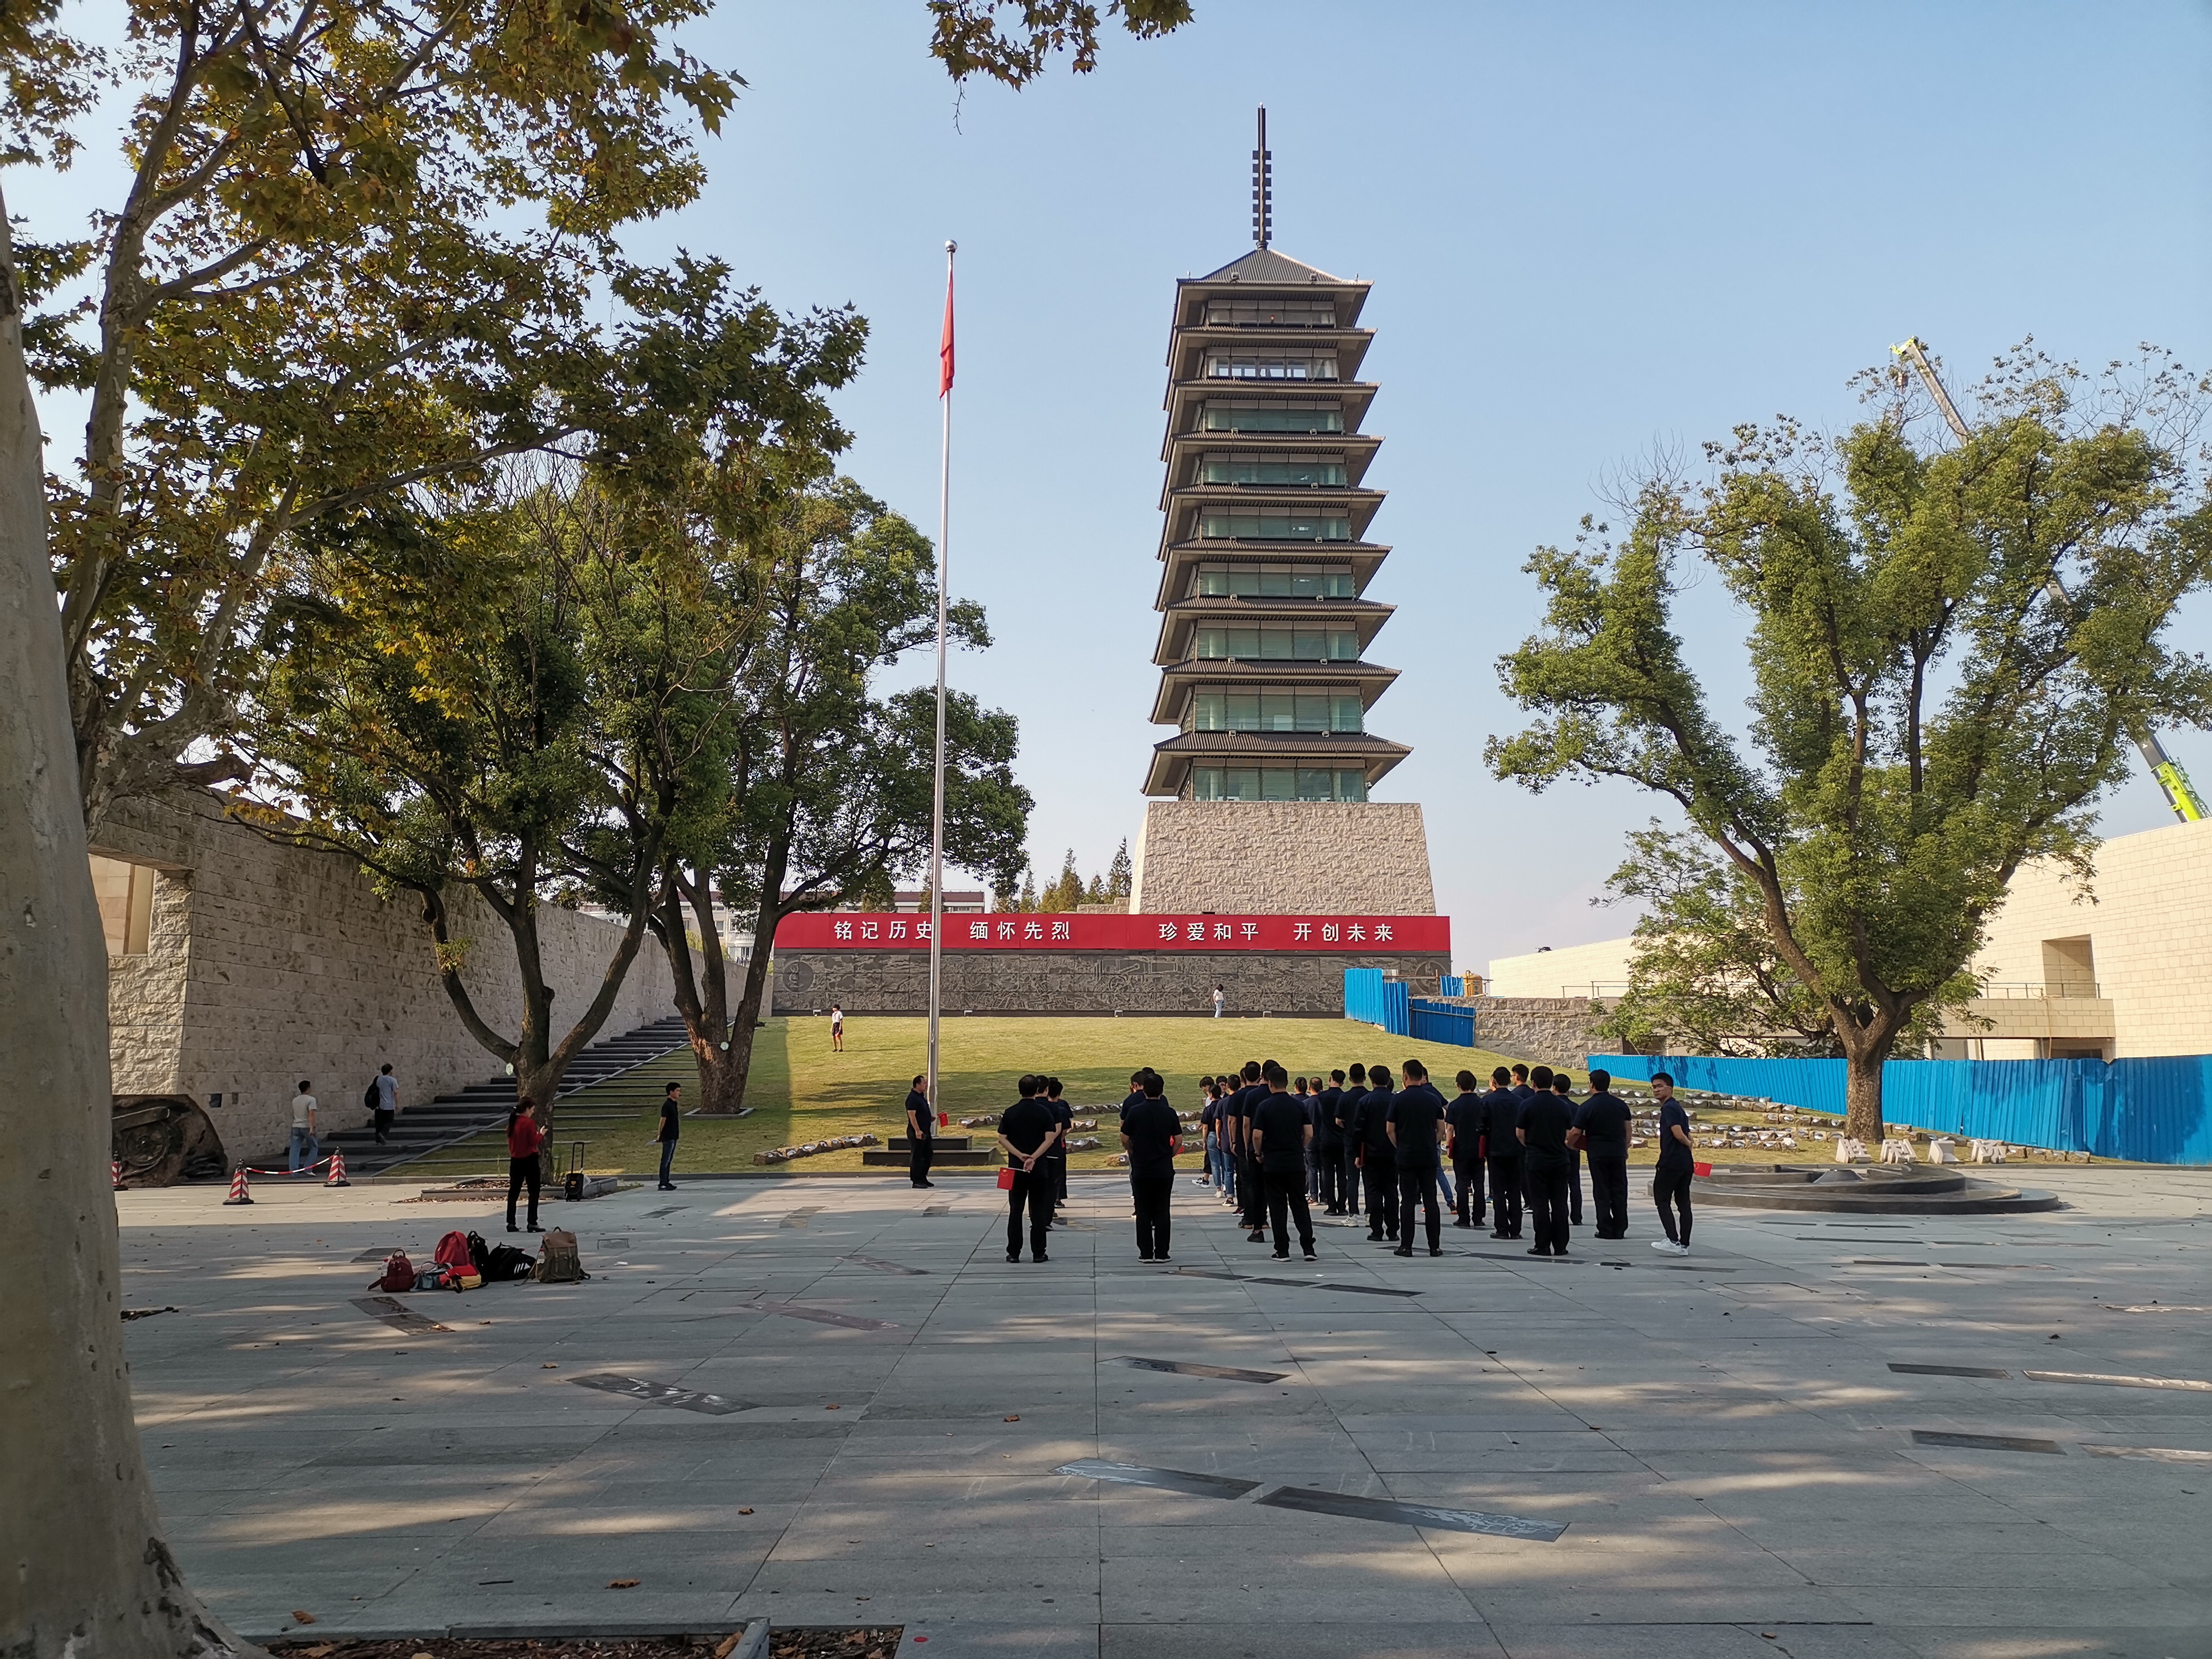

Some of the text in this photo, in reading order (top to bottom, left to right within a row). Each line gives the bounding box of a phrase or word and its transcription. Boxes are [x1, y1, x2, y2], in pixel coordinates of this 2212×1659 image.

[833, 921, 1394, 941] 铭记历史 缅怀先烈 珍爱和平 开创未来
